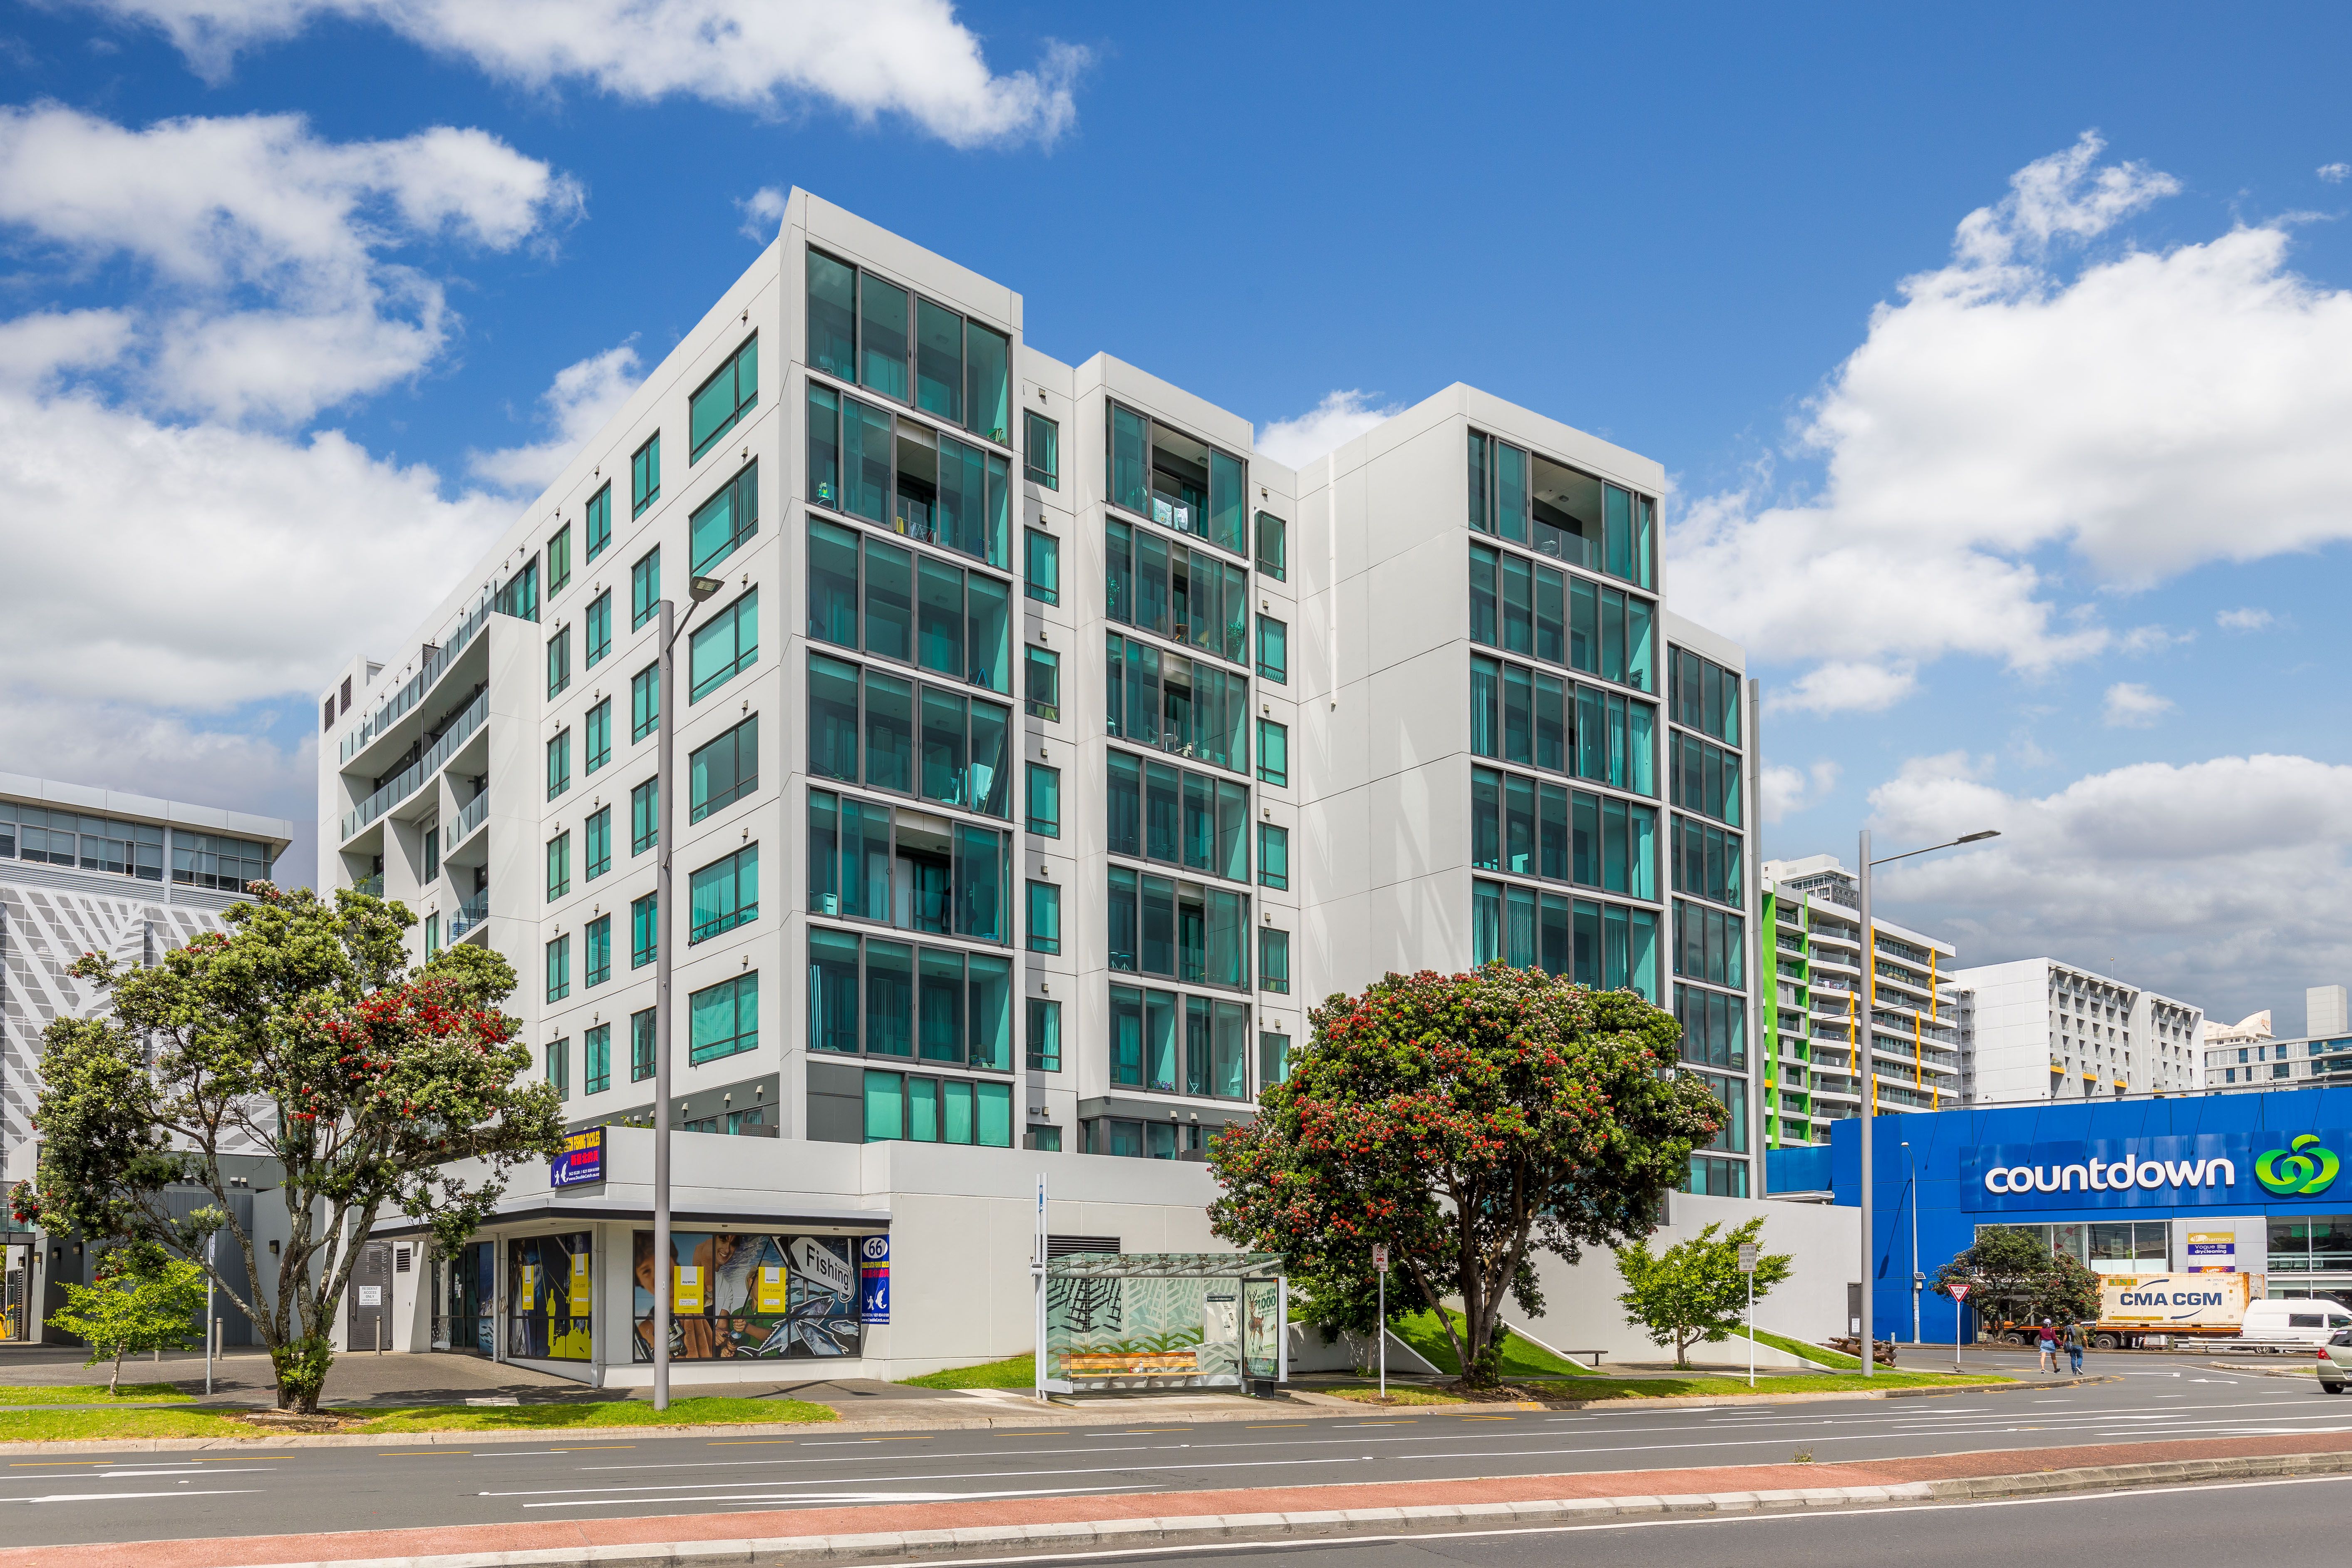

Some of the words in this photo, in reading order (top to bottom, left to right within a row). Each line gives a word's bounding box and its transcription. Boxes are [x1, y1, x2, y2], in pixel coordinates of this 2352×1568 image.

[573, 1134, 586, 1151] FISHING
[586, 1130, 600, 1148] TACKLES
[1985, 1154, 2235, 1193] countdown
[868, 1240, 882, 1256] 66
[806, 1243, 849, 1290] Fishing
[1267, 1287, 1276, 1295] WIN
[2120, 1293, 2168, 1305] CMA
[2173, 1293, 2222, 1305] CGM
[1255, 1295, 1276, 1310] $1,000
